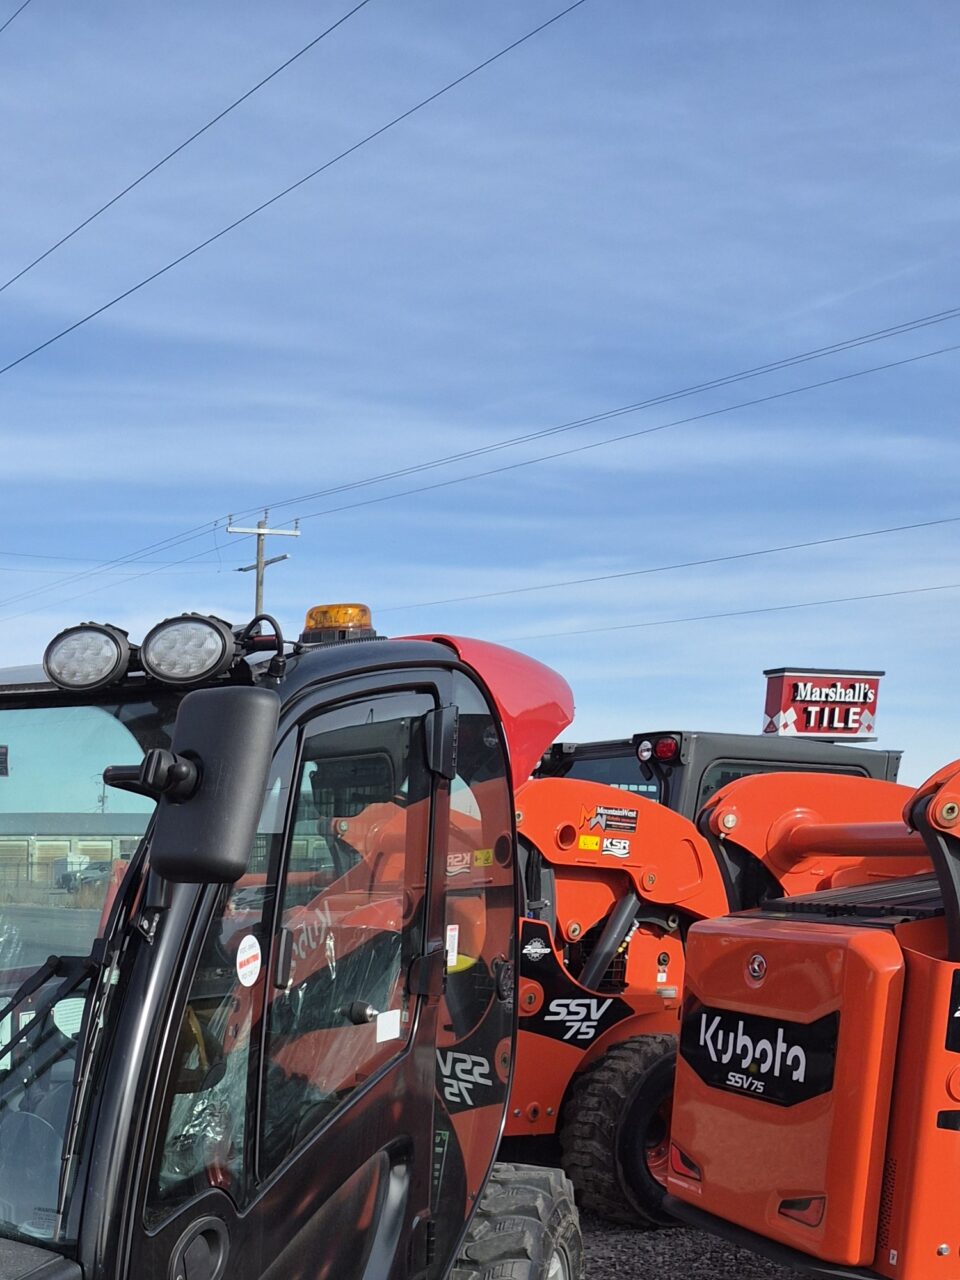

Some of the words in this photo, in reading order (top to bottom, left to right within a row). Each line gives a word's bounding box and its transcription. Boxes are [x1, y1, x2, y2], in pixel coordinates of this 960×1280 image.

[795, 682, 876, 703] Marshall's
[807, 706, 861, 728] TILE
[603, 838, 630, 850] KSR
[544, 998, 614, 1020] SSV
[562, 1021, 598, 1039] 75
[699, 1013, 806, 1083] Kubota
